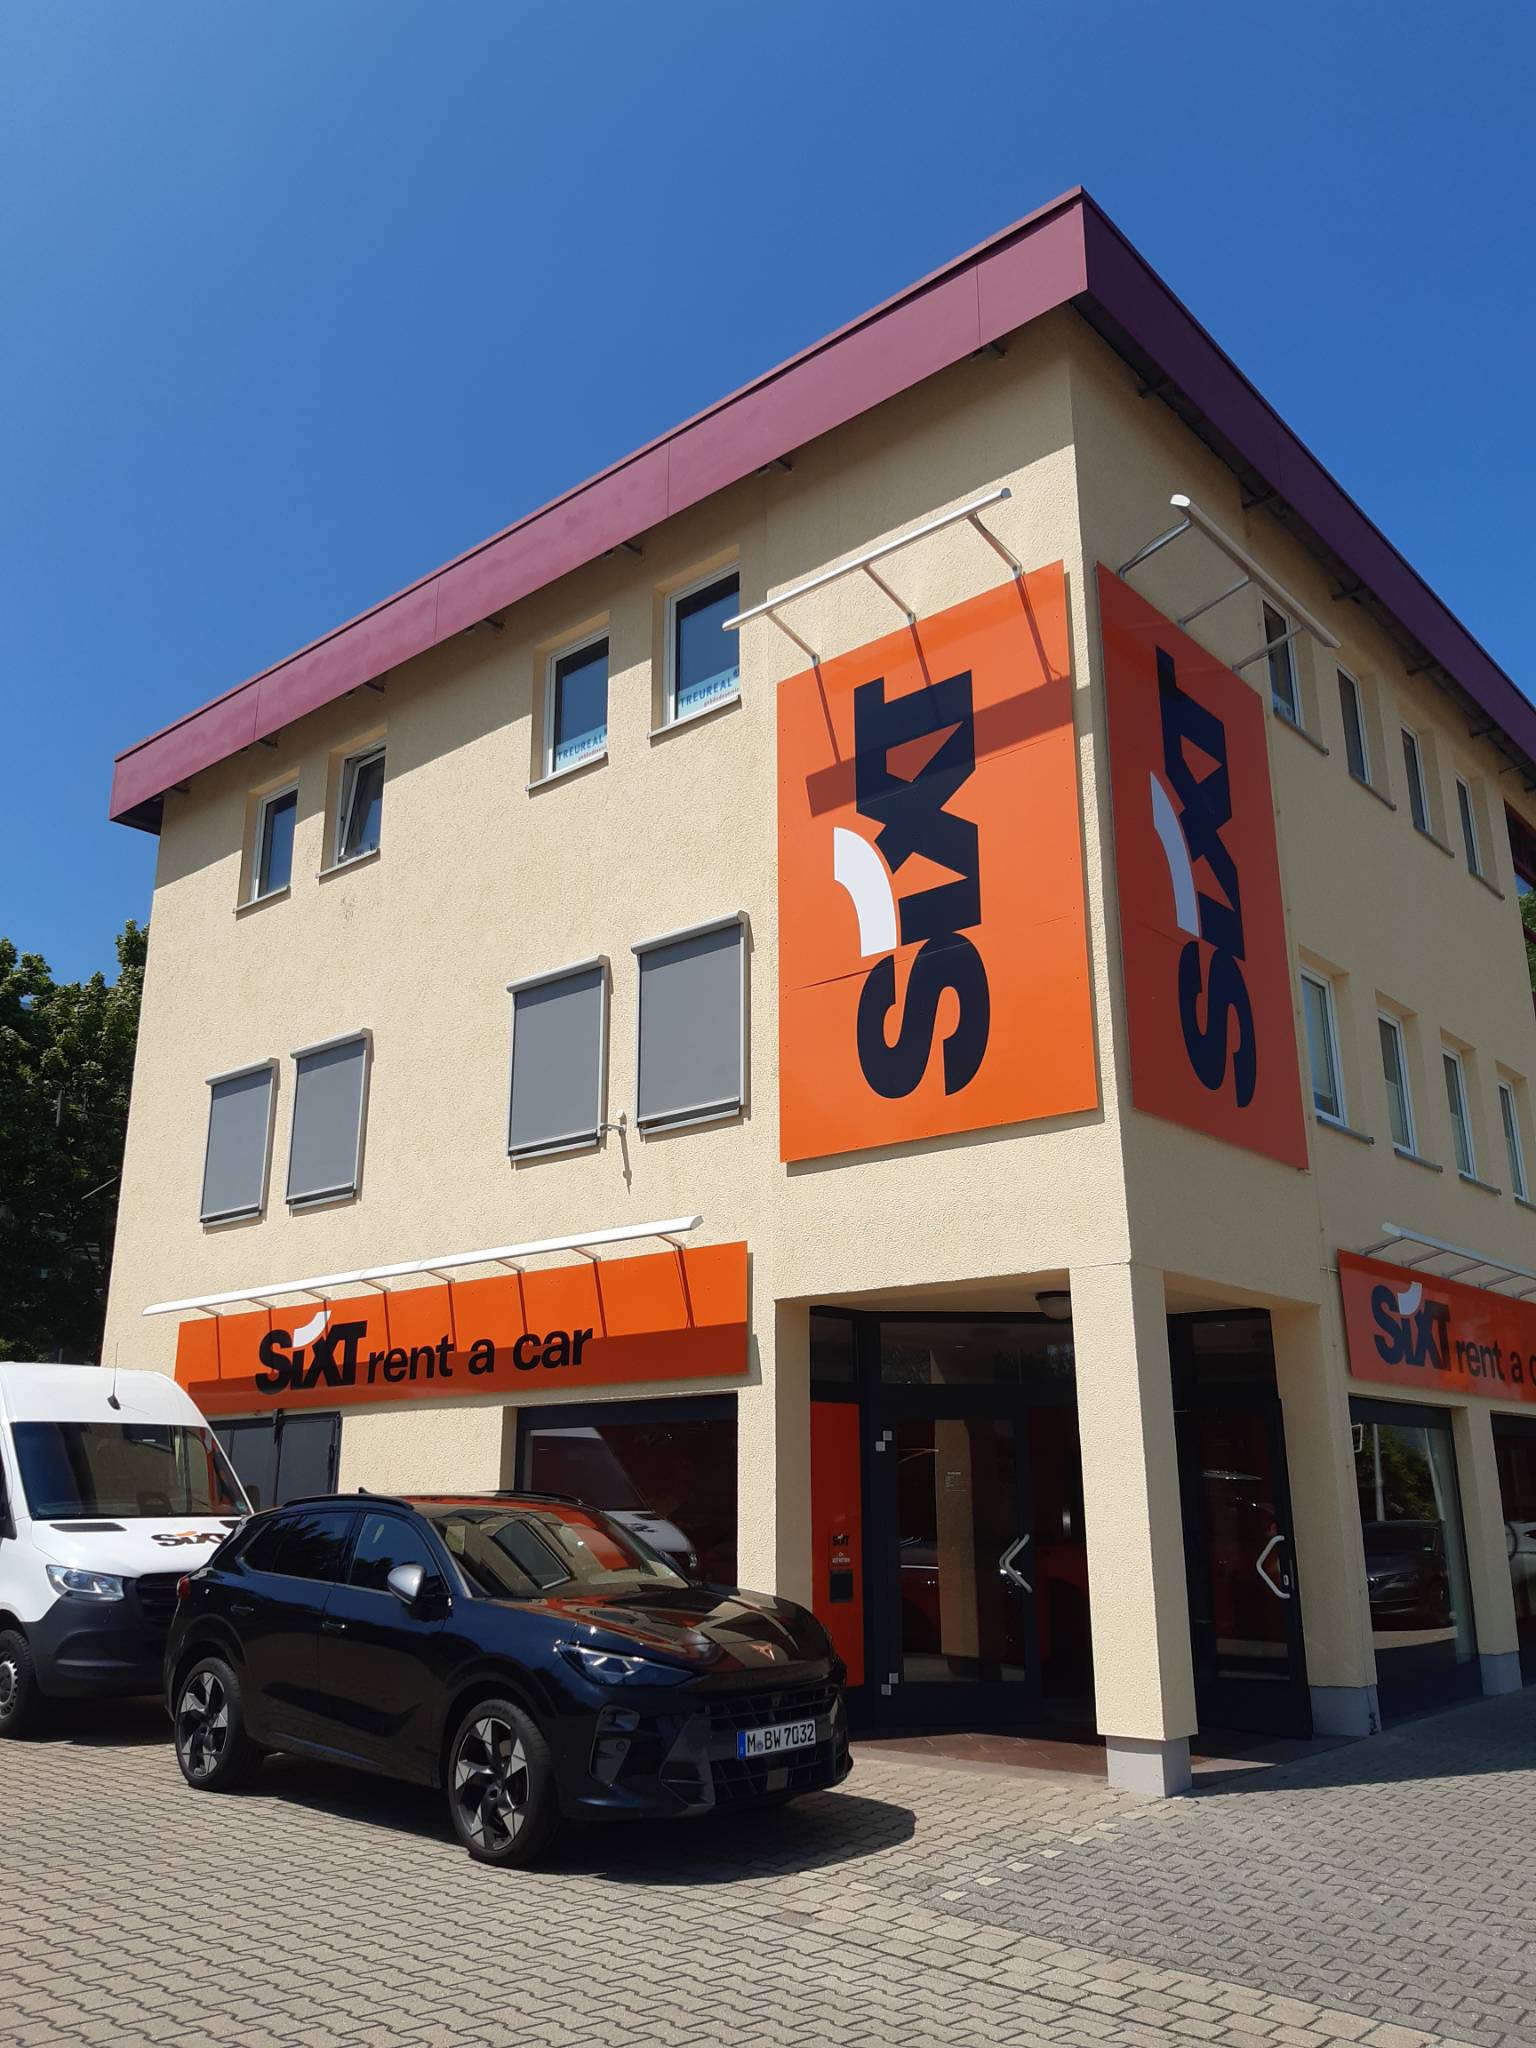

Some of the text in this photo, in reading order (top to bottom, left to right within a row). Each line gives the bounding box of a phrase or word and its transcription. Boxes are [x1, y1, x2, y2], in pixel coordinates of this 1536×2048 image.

[680, 677, 733, 708] TREUREAL
[557, 733, 605, 761] TREUREAL
[368, 1334, 455, 1384] rent
[469, 1338, 495, 1374] a
[513, 1327, 594, 1371] car
[1456, 1339, 1505, 1381] rent
[1510, 1350, 1524, 1384] a
[747, 1723, 814, 1753] M BW 7032
